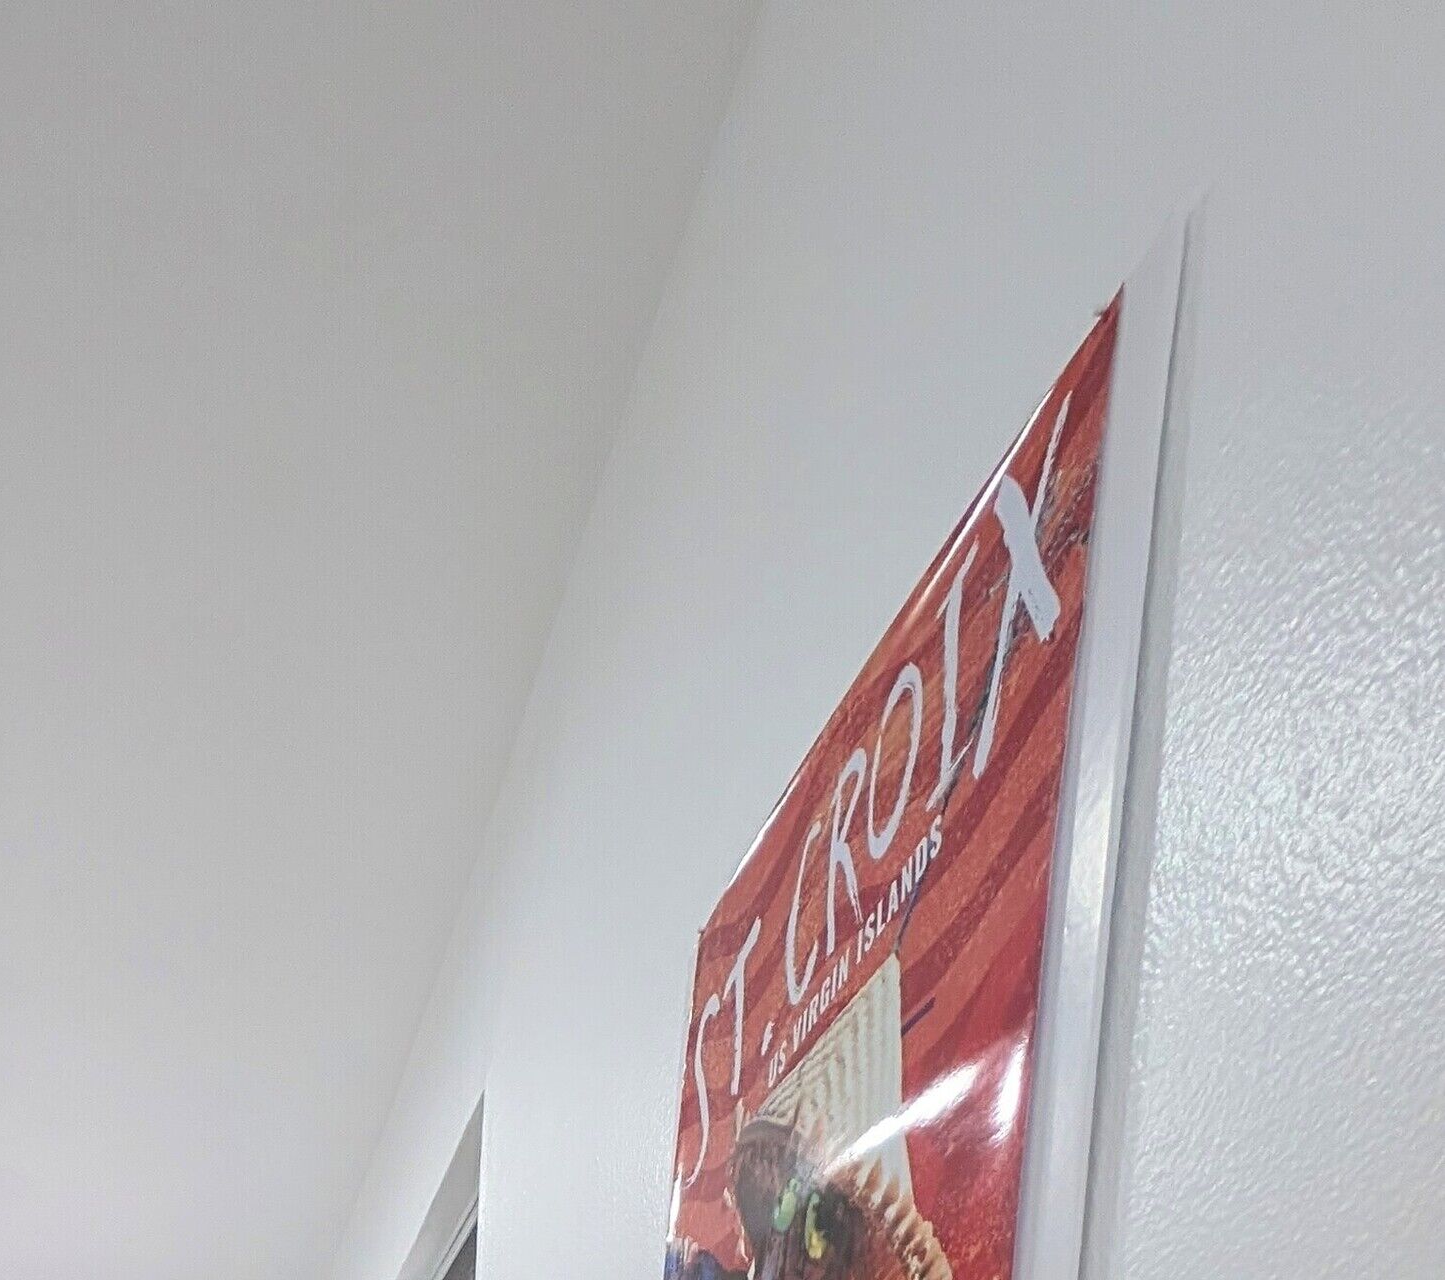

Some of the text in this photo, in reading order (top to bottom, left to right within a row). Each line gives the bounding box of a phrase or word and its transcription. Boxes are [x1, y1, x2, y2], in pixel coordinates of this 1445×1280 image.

[680, 391, 1071, 1187] ST. CROIX
[768, 815, 944, 1089] US VIRGIN ISLANDS
